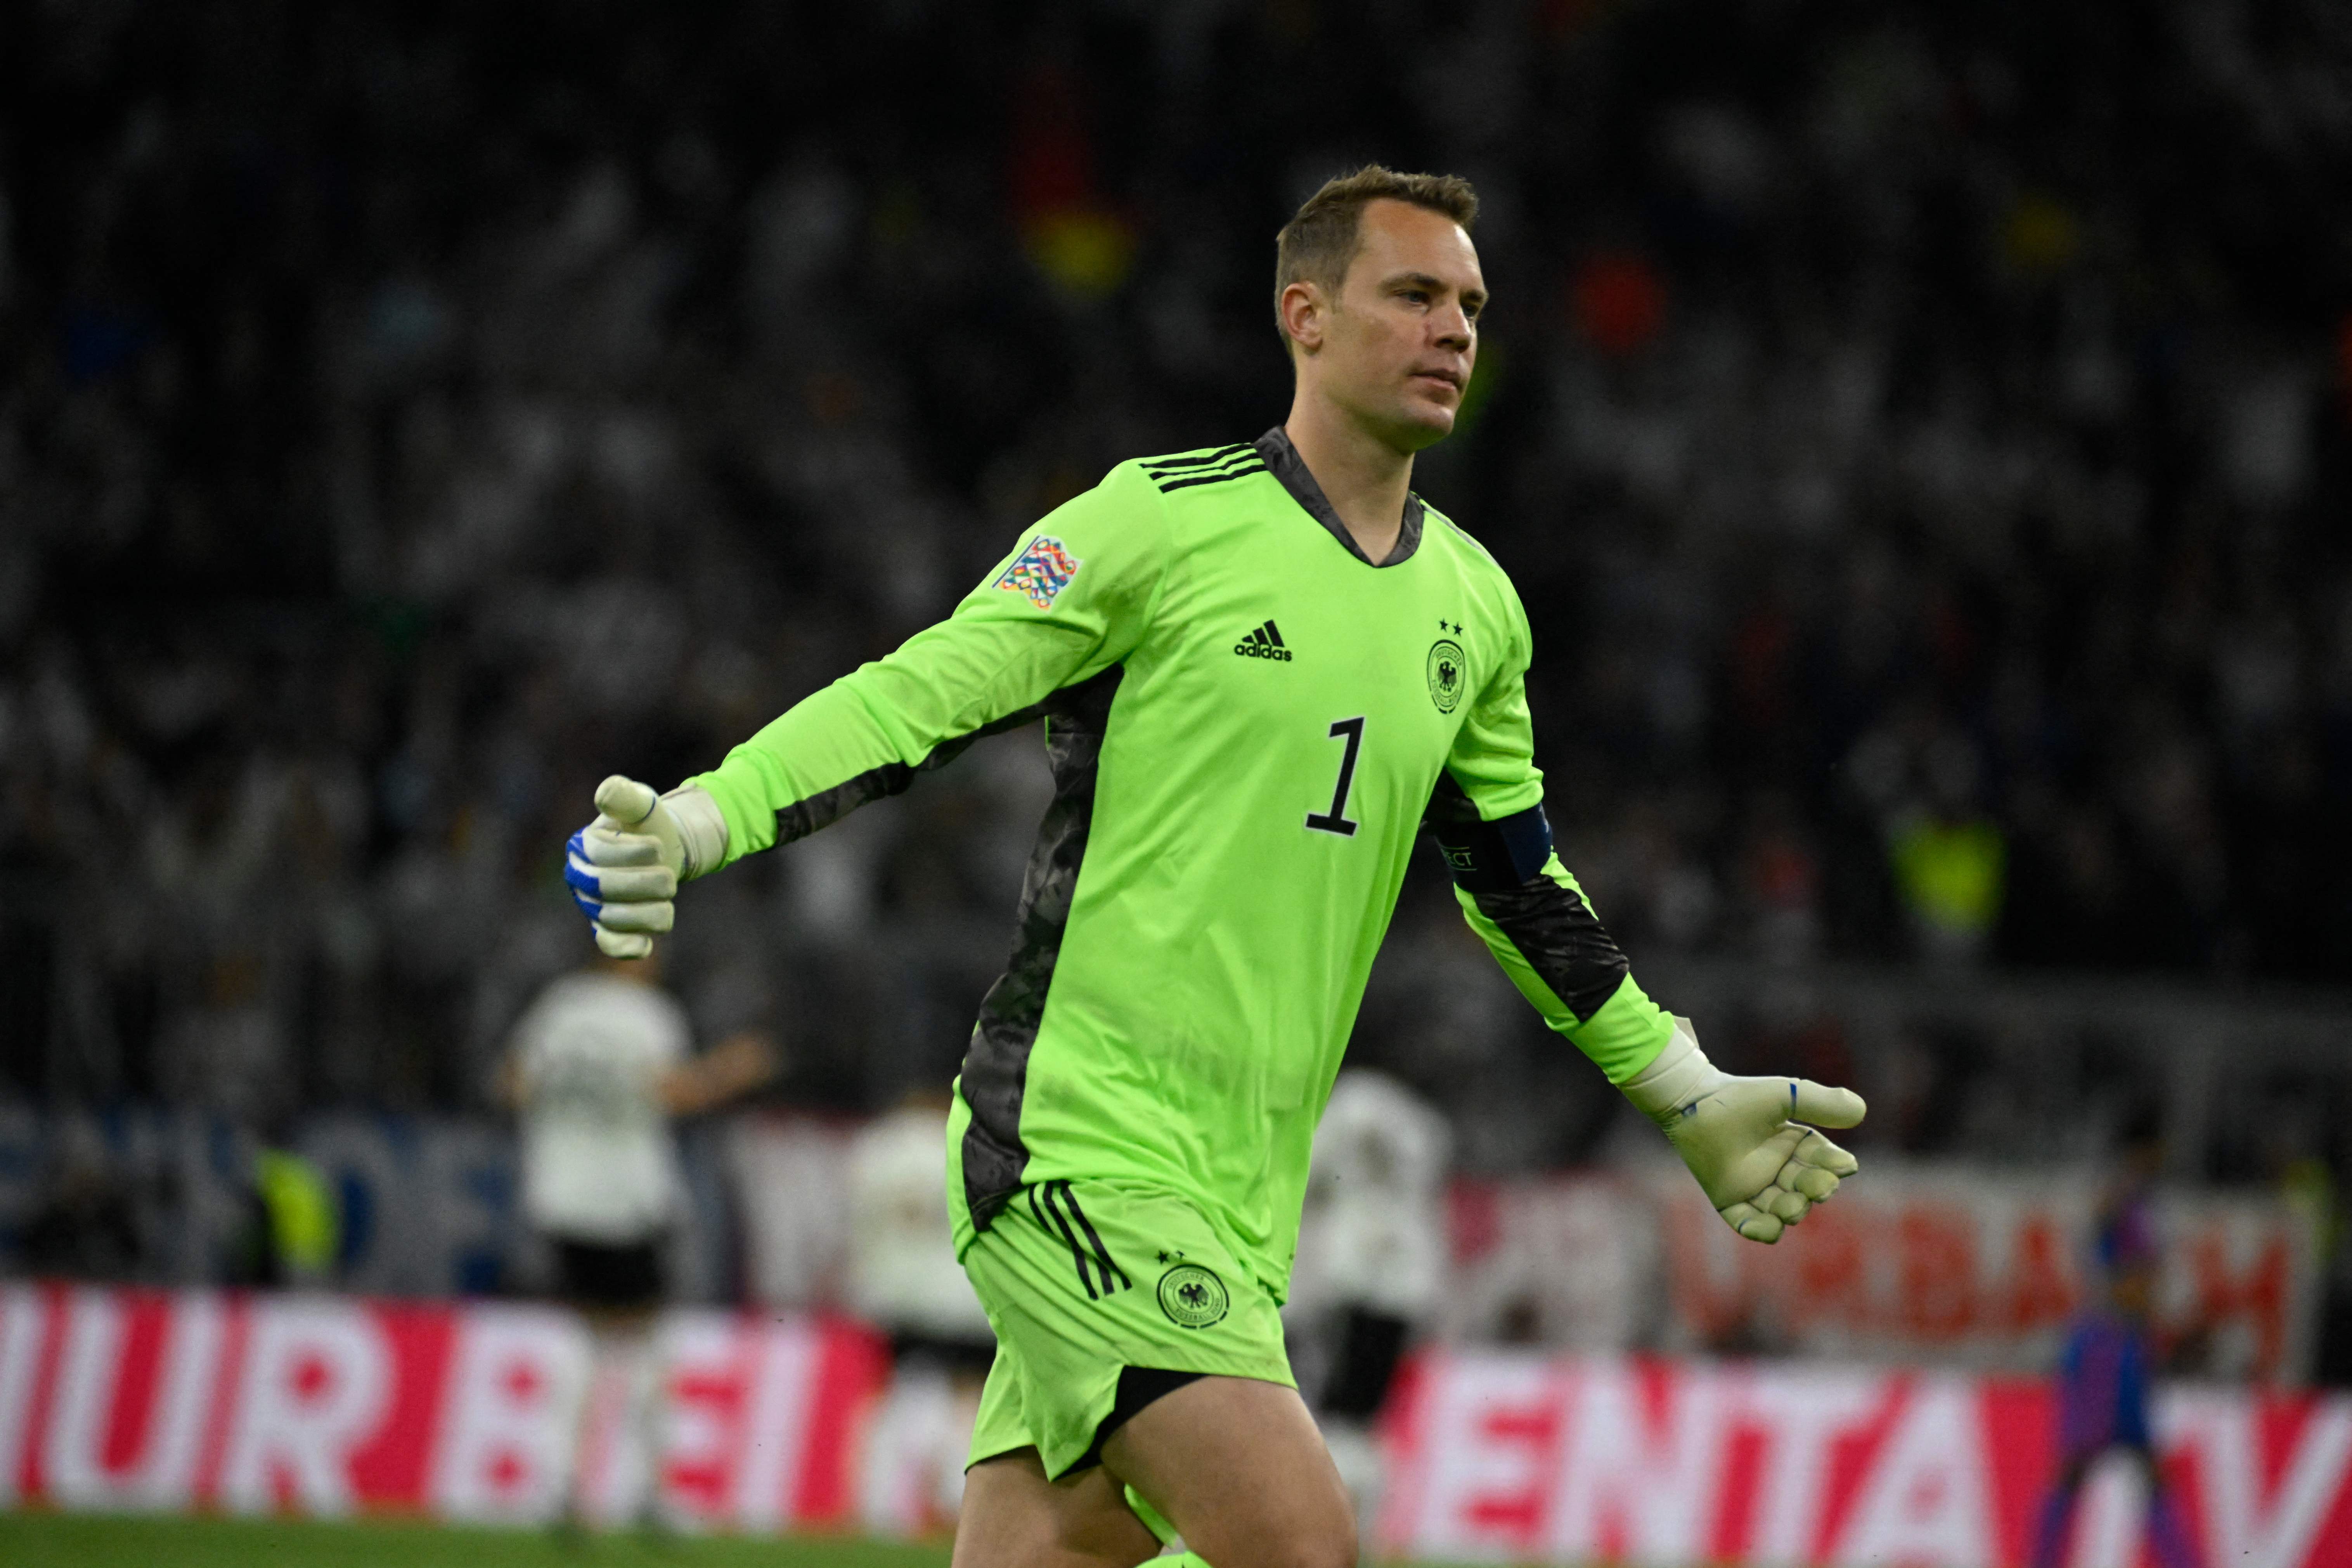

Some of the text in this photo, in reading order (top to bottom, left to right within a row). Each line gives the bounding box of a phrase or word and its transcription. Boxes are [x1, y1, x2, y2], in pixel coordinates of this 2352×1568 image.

[1233, 642, 1292, 662] adidas
[1305, 716, 1365, 837] 1
[1397, 1346, 2025, 1568] ENTA
